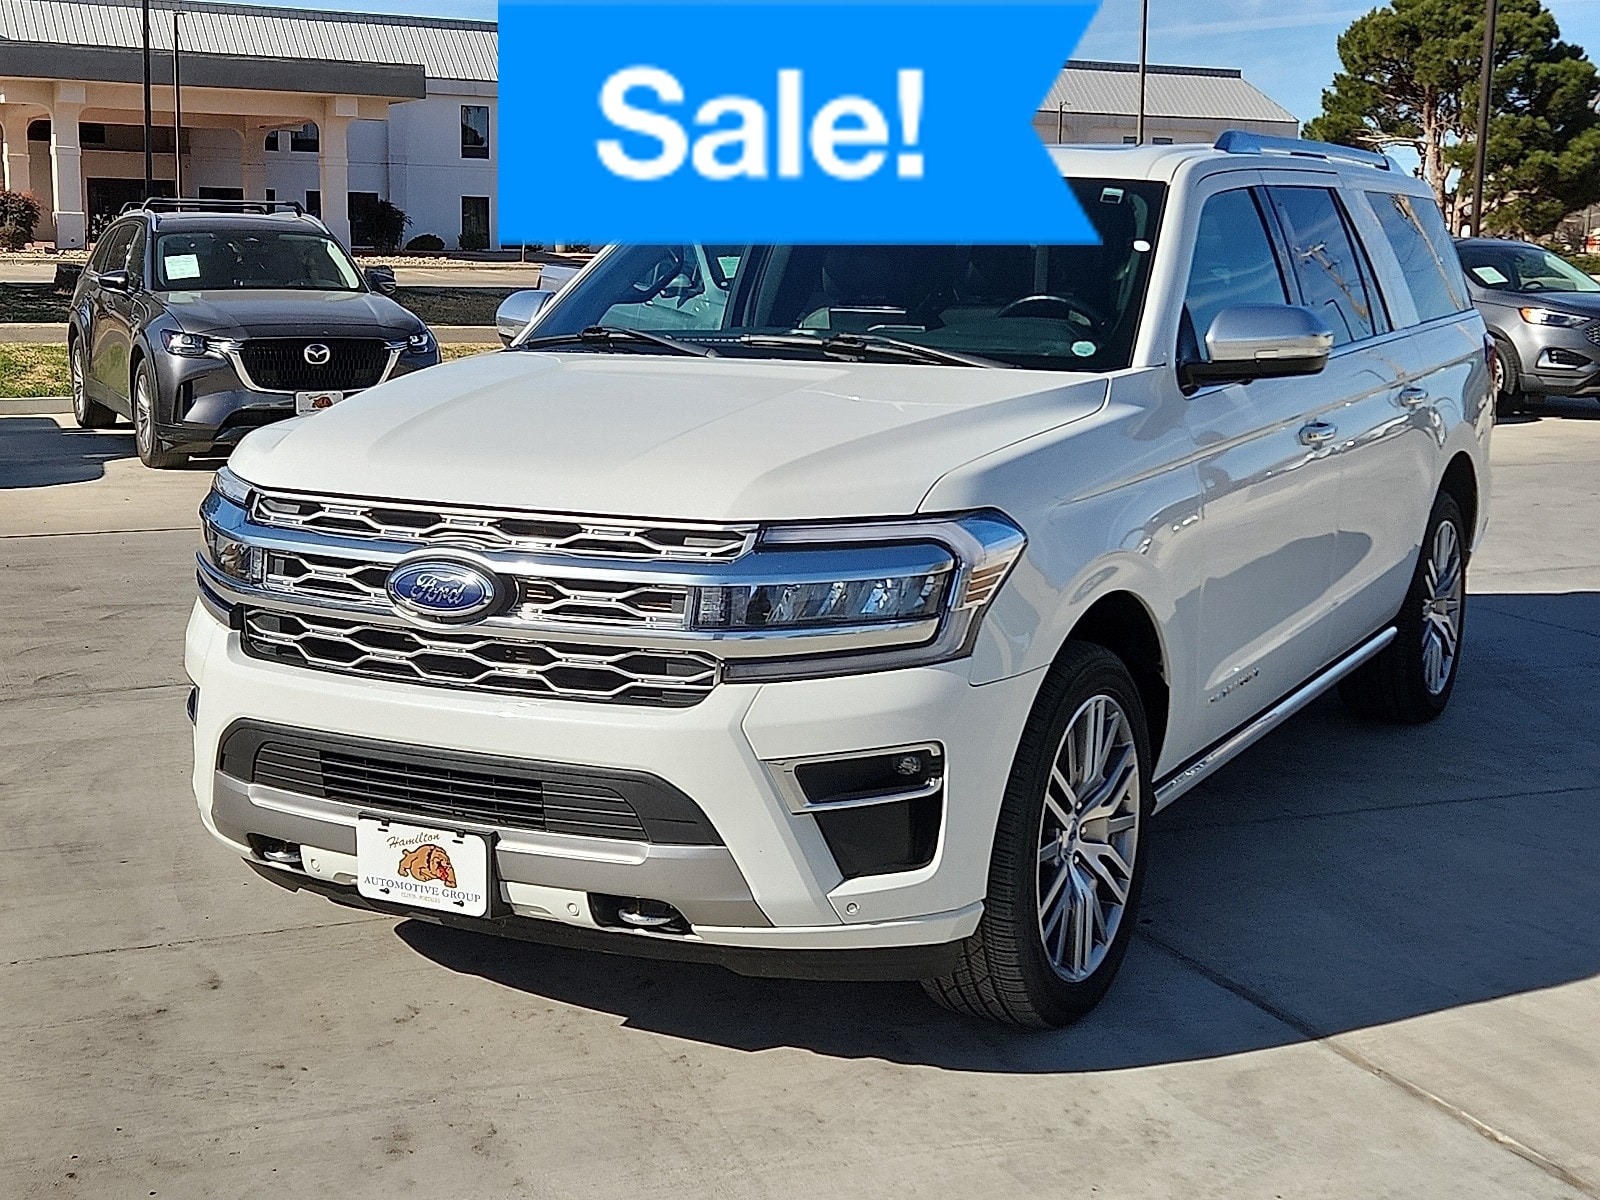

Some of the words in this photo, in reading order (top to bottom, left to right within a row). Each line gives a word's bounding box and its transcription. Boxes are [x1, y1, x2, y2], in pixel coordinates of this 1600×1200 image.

[410, 574, 467, 605] Ford
[386, 832, 441, 848] Hamilton
[364, 875, 440, 896] AUTOMOTIVE
[442, 888, 481, 903] GROUP
